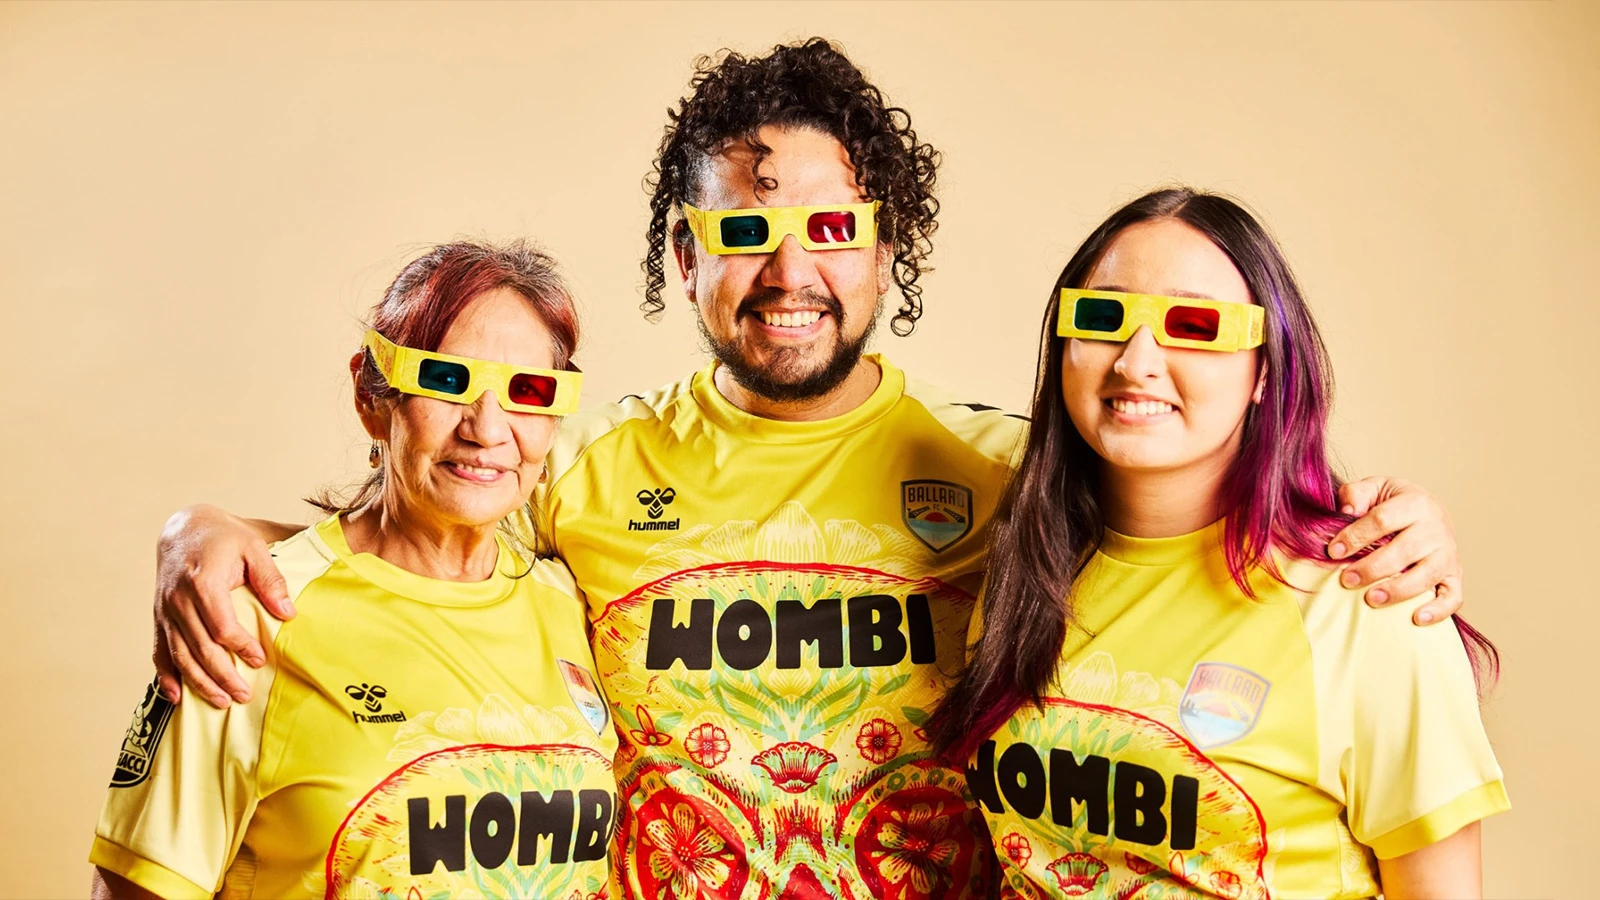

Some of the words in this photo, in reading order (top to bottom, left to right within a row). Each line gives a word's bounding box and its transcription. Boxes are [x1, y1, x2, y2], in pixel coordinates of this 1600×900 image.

[908, 487, 965, 508] BALLARD
[933, 503, 940, 511] FC
[628, 518, 680, 531] hummel
[646, 594, 936, 670] WOMBI
[352, 710, 407, 724] hummel
[407, 789, 618, 876] WOMB
